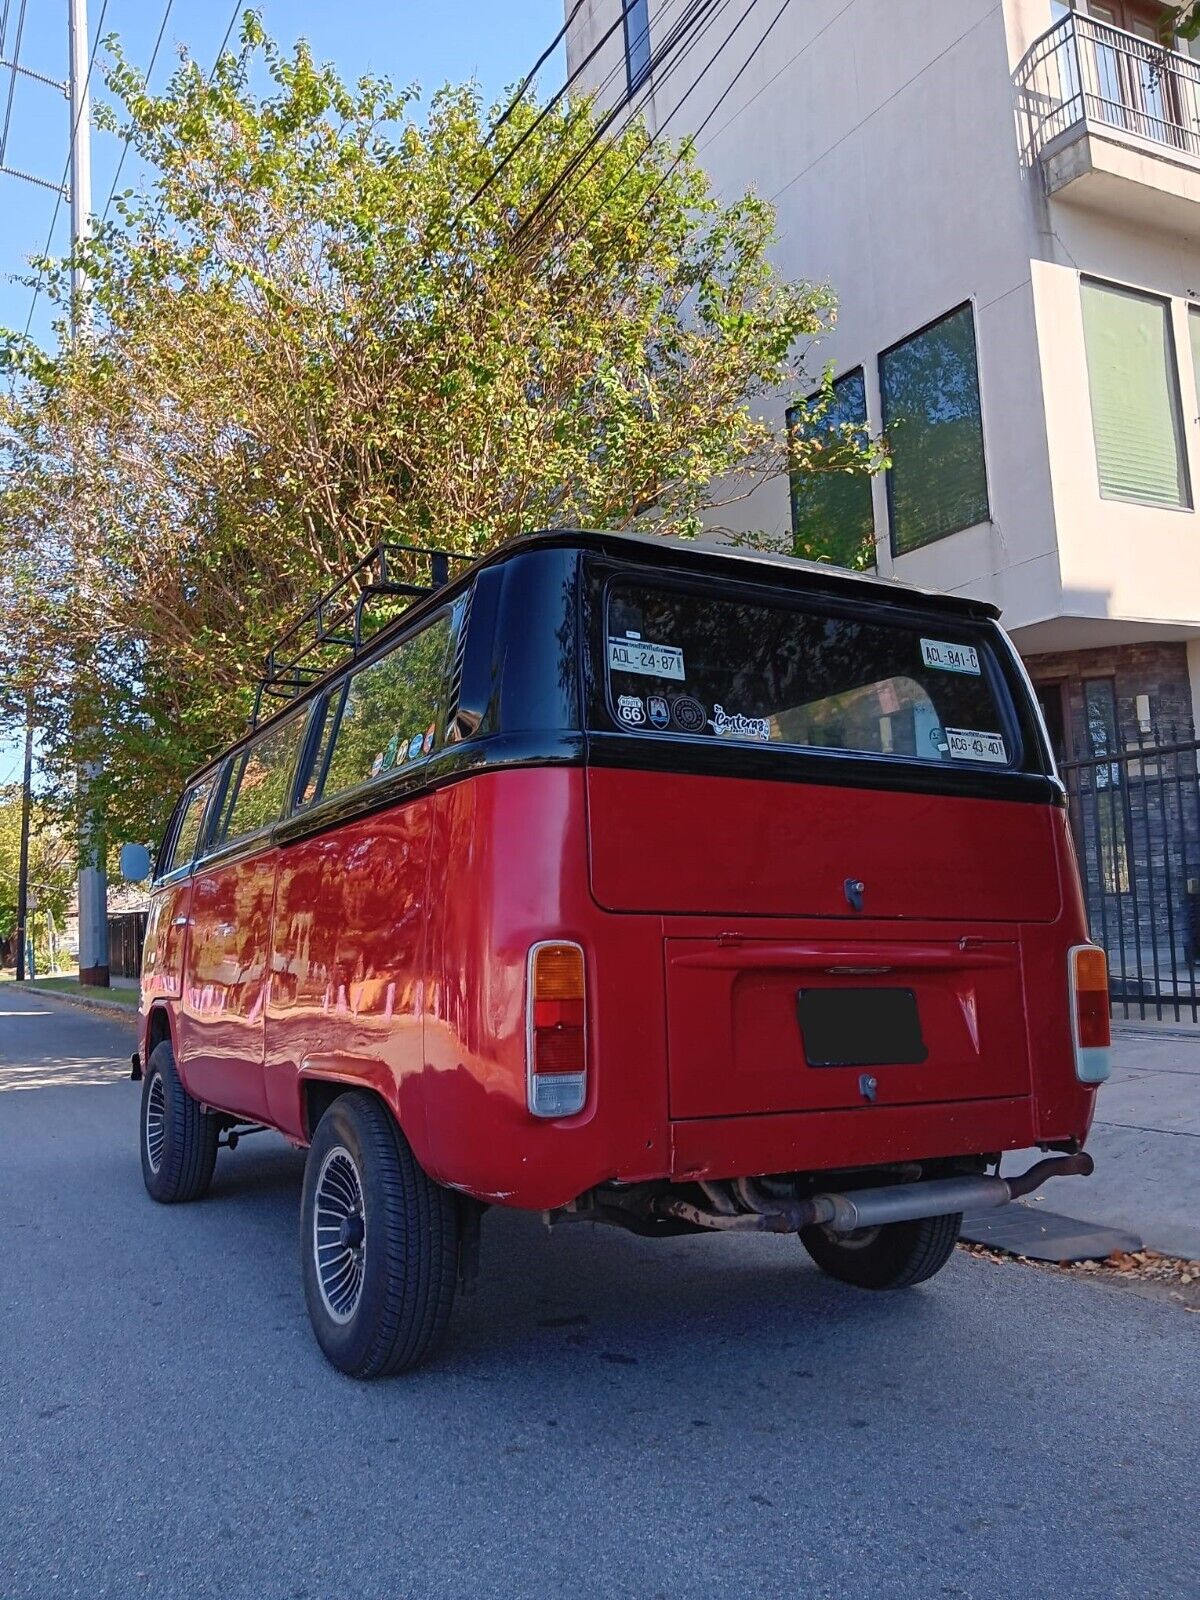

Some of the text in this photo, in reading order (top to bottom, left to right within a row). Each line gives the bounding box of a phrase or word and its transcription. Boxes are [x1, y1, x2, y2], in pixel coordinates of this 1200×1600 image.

[925, 646, 978, 668] ACL-841-C
[622, 707, 641, 721] 66
[716, 712, 765, 732] Canteras
